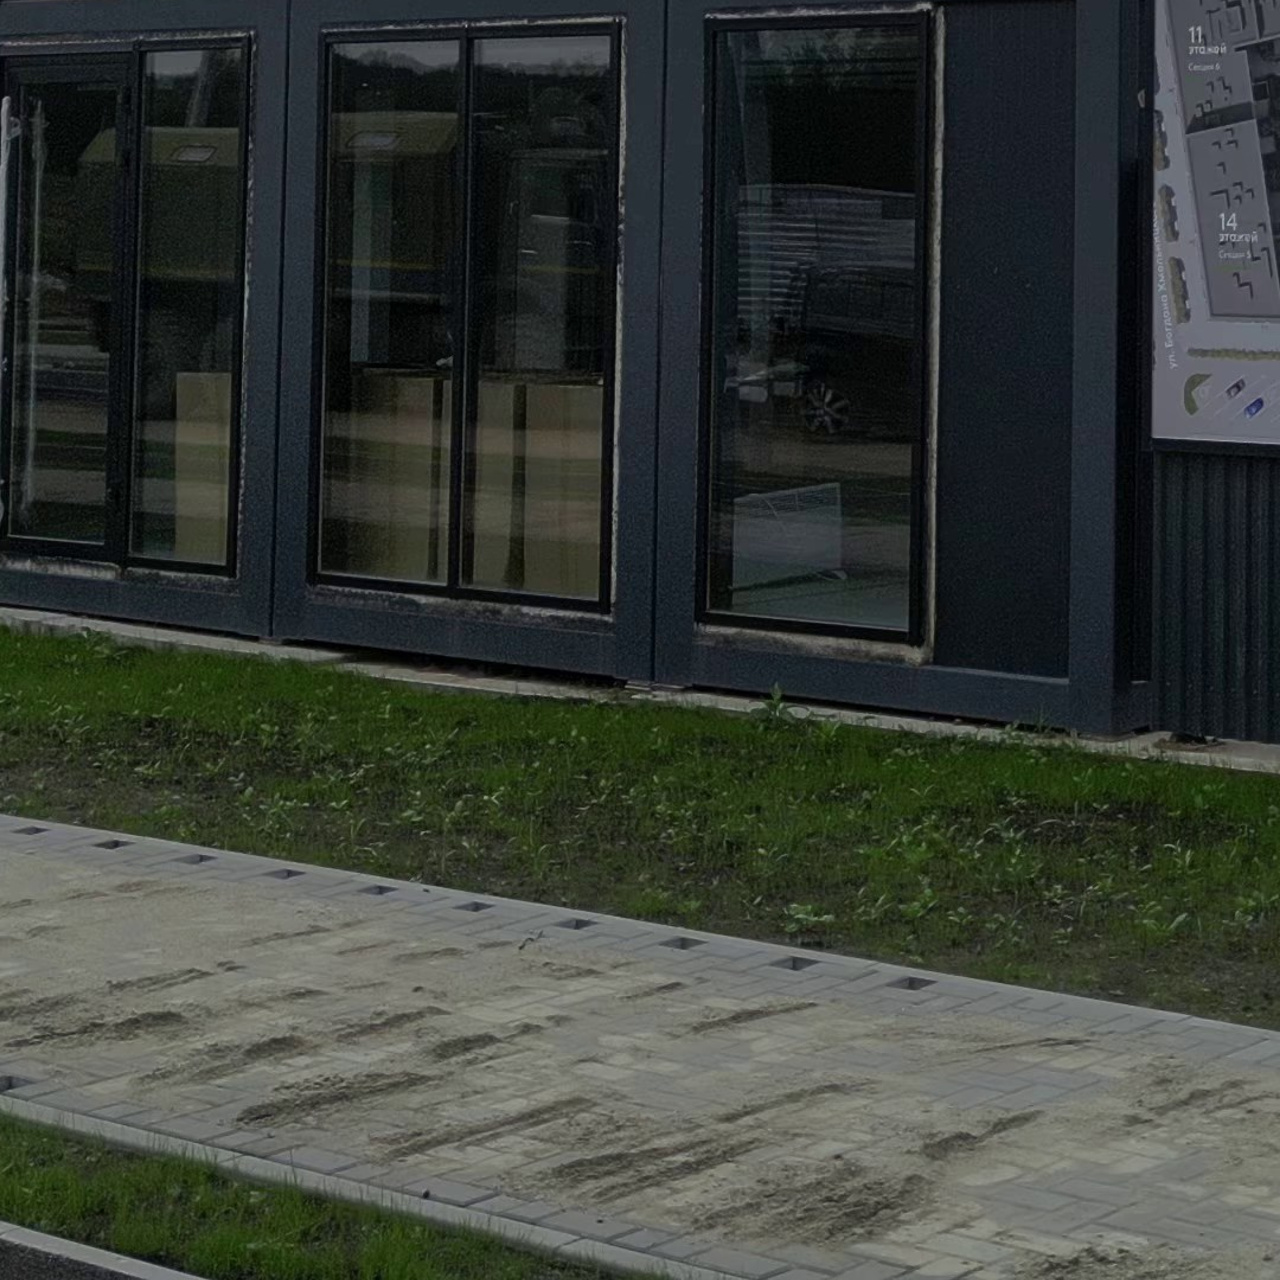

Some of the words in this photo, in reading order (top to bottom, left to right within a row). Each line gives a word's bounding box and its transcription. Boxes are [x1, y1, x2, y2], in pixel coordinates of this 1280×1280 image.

[1188, 25, 1202, 44] 11
[1188, 42, 1227, 55] этажей
[1219, 212, 1238, 231] 14
[1218, 231, 1258, 243] этажей
[1160, 294, 1174, 348] Богдана
